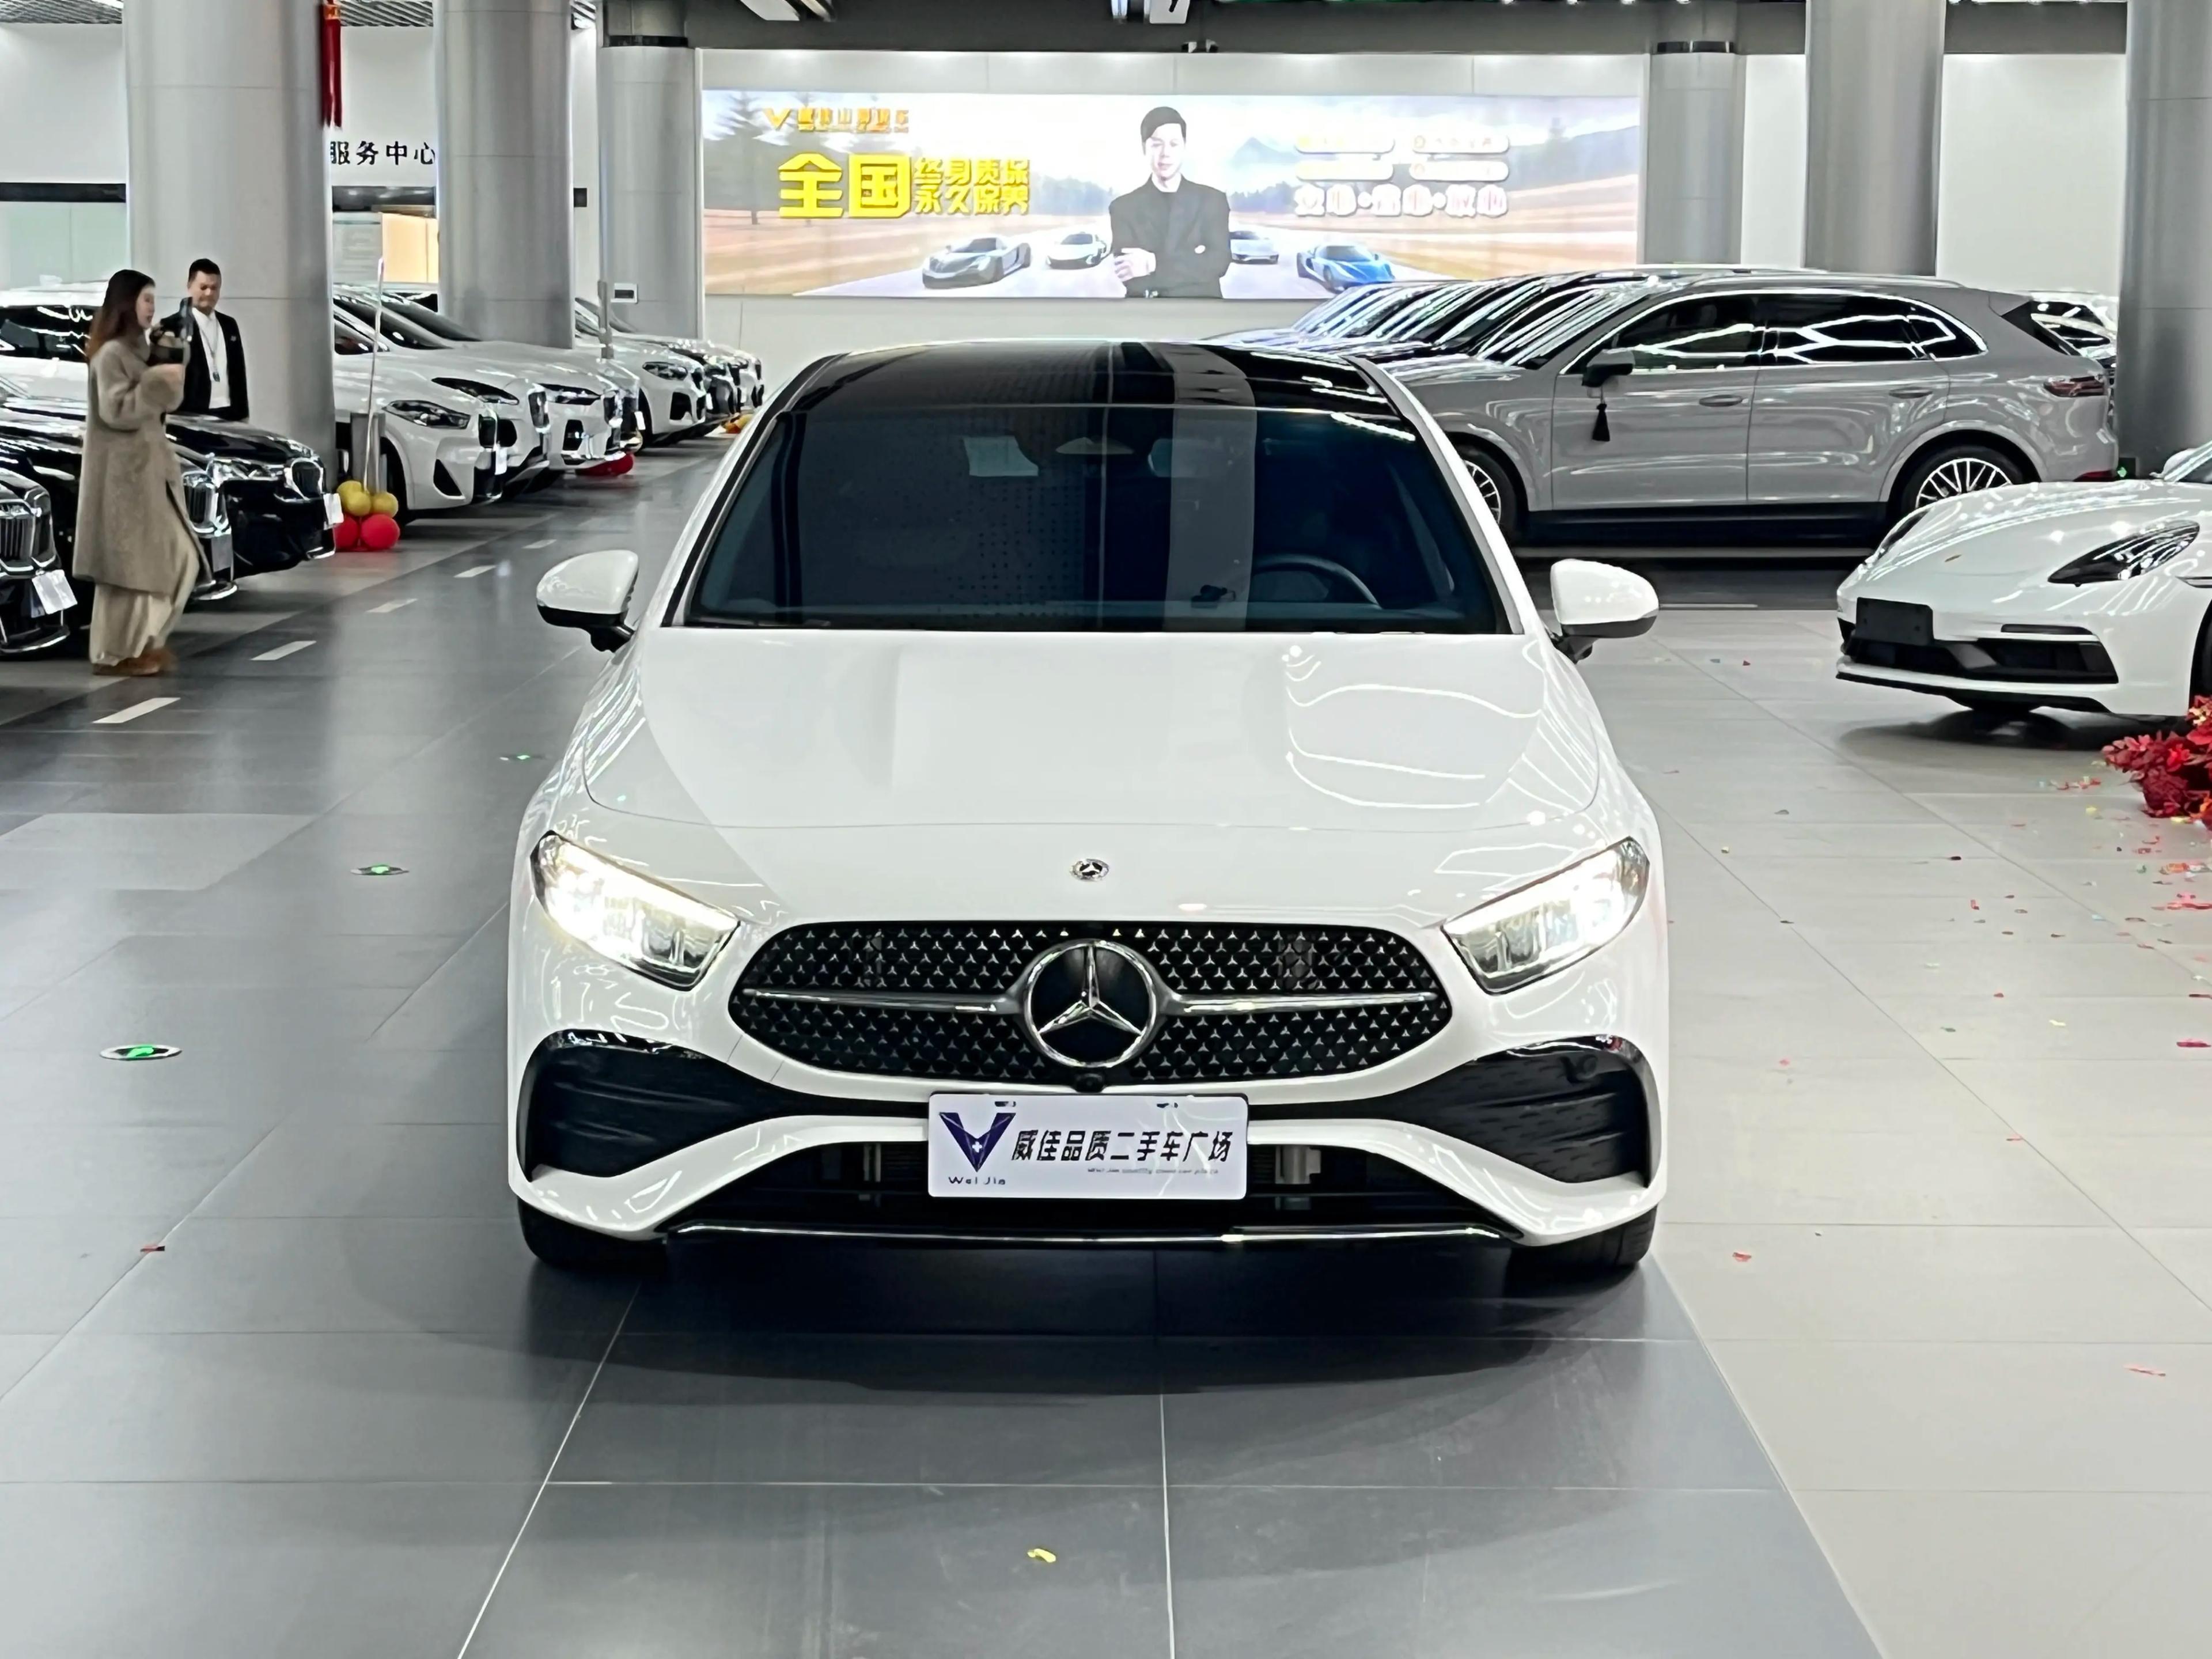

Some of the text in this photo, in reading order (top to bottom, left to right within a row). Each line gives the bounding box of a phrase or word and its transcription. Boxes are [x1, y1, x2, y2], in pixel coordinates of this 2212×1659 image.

[330, 141, 436, 165] 服务中心
[778, 153, 913, 218] 全国
[914, 157, 1029, 187] 终身质保
[914, 184, 1029, 216] 永久保养
[1012, 1130, 1233, 1161] 威佳品质二手车广场
